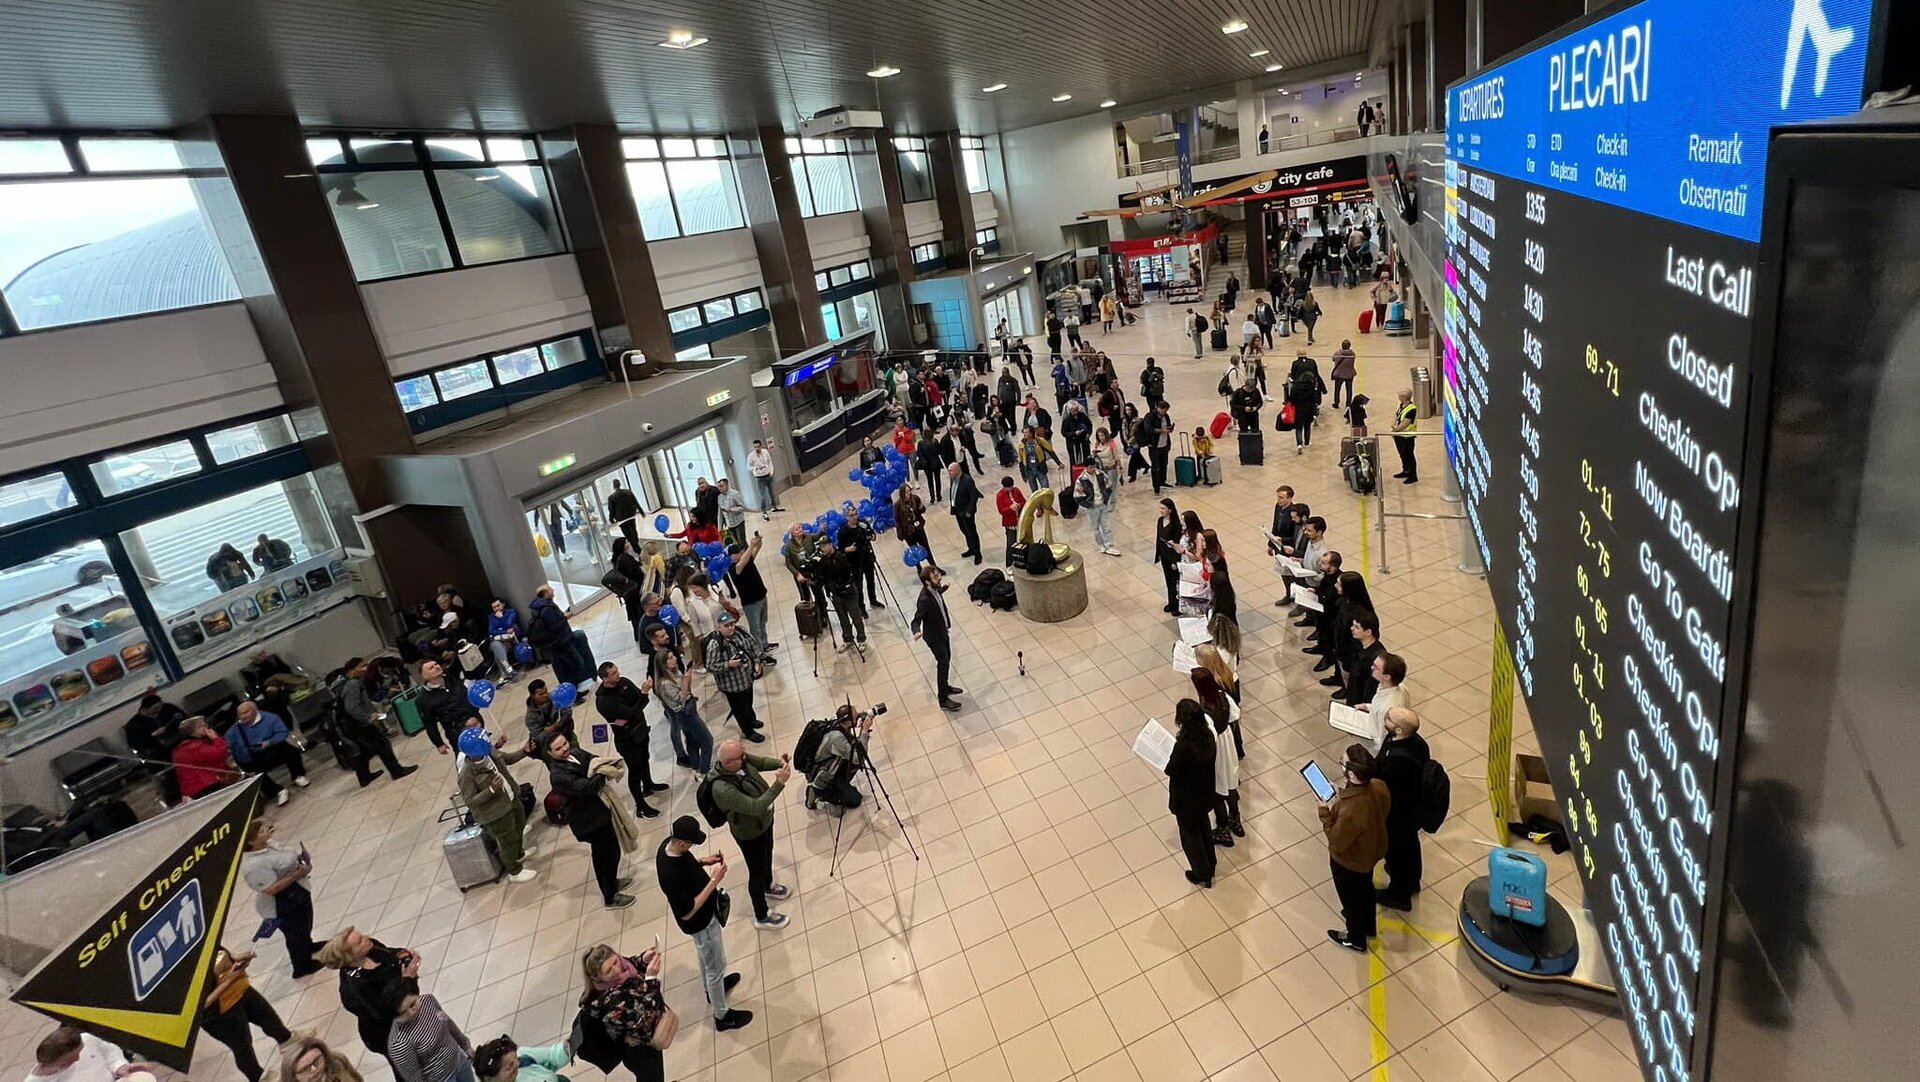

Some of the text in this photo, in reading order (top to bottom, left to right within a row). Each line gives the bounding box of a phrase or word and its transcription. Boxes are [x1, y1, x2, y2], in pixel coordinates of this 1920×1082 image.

[1549, 19, 1652, 112] PLECARI
[1459, 76, 1504, 122] DEPARTURES
[1596, 132, 1628, 156] Check-in
[1689, 131, 1743, 165] Remark
[1278, 165, 1334, 186] city cafe
[1290, 195, 1317, 206] 53-104
[1595, 165, 1627, 192] Check-in
[1679, 178, 1748, 217] Observatii
[1525, 191, 1545, 225] 13:55
[1524, 238, 1545, 275] 14:20
[1665, 245, 1752, 318] Last Call
[1524, 284, 1544, 323] 14:30
[1523, 327, 1542, 370] 14:35
[1586, 344, 1598, 374] 69
[1606, 360, 1619, 397] 71
[1668, 333, 1734, 409] Closed
[1522, 371, 1541, 415] 14:35
[1521, 413, 1540, 459] 14:45
[1639, 391, 1740, 512] Checkin Op
[1520, 453, 1539, 500] 15:00
[1581, 459, 1593, 493] 01
[1600, 486, 1613, 521] 11
[1635, 459, 1668, 521] Now
[1518, 492, 1537, 543] 15:15
[1580, 510, 1591, 547] 72
[1598, 540, 1611, 578] 75
[1577, 564, 1589, 597] 60
[1595, 599, 1607, 634] 65
[1639, 541, 1661, 589] Go
[1663, 570, 1683, 620] To
[1575, 615, 1586, 650] 01
[1593, 653, 1604, 689] 11
[1628, 594, 1719, 760] Checkin Op
[1573, 662, 1584, 698] 01
[1590, 702, 1602, 739] 03
[1624, 654, 1677, 771] Checkin
[1628, 728, 1648, 780] Go
[1650, 768, 1667, 821] To
[1617, 769, 1668, 897] Checkin
[78, 822, 231, 969] Self Check-In
[1614, 822, 1663, 954] Checkin
[1611, 873, 1659, 1010] Checkin
[1608, 922, 1655, 1064] Checkin
